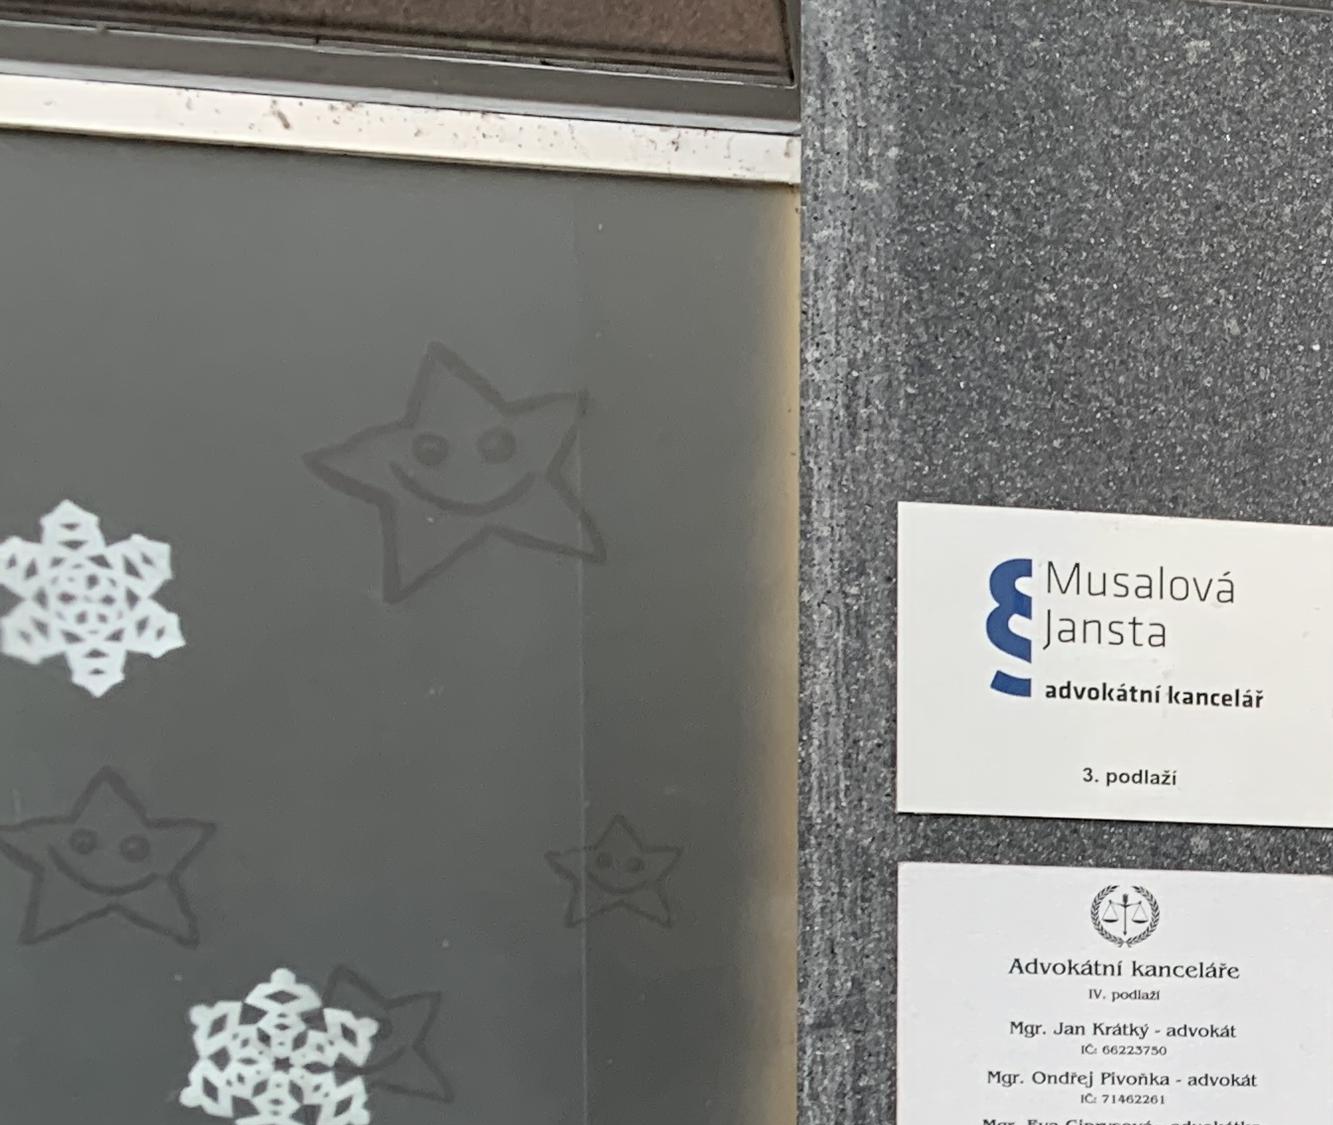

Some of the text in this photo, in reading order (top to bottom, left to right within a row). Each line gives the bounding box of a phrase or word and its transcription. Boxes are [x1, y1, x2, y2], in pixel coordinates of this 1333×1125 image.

[1046, 560, 1235, 604] Musalová
[1042, 608, 1166, 651] Jansta
[1044, 679, 1265, 709] advokátní kancelář
[1082, 766, 1177, 788] 3. podlaží
[1007, 957, 1241, 980] Advokátní kanceláře
[1088, 988, 1161, 1003] IV. podlaží
[1009, 1020, 1047, 1039] Mgr.
[1052, 1021, 1086, 1036] Jan
[1092, 1022, 1150, 1041] Krátký
[1165, 1023, 1237, 1039] advokát
[1101, 1044, 1168, 1056] 66223750
[987, 1070, 1024, 1088] Mgr.
[1031, 1070, 1094, 1089] Ondřej
[1100, 1071, 1170, 1086] Pivoňka
[1187, 1072, 1258, 1088] advokát
[1101, 1094, 1165, 1105] 71462261
